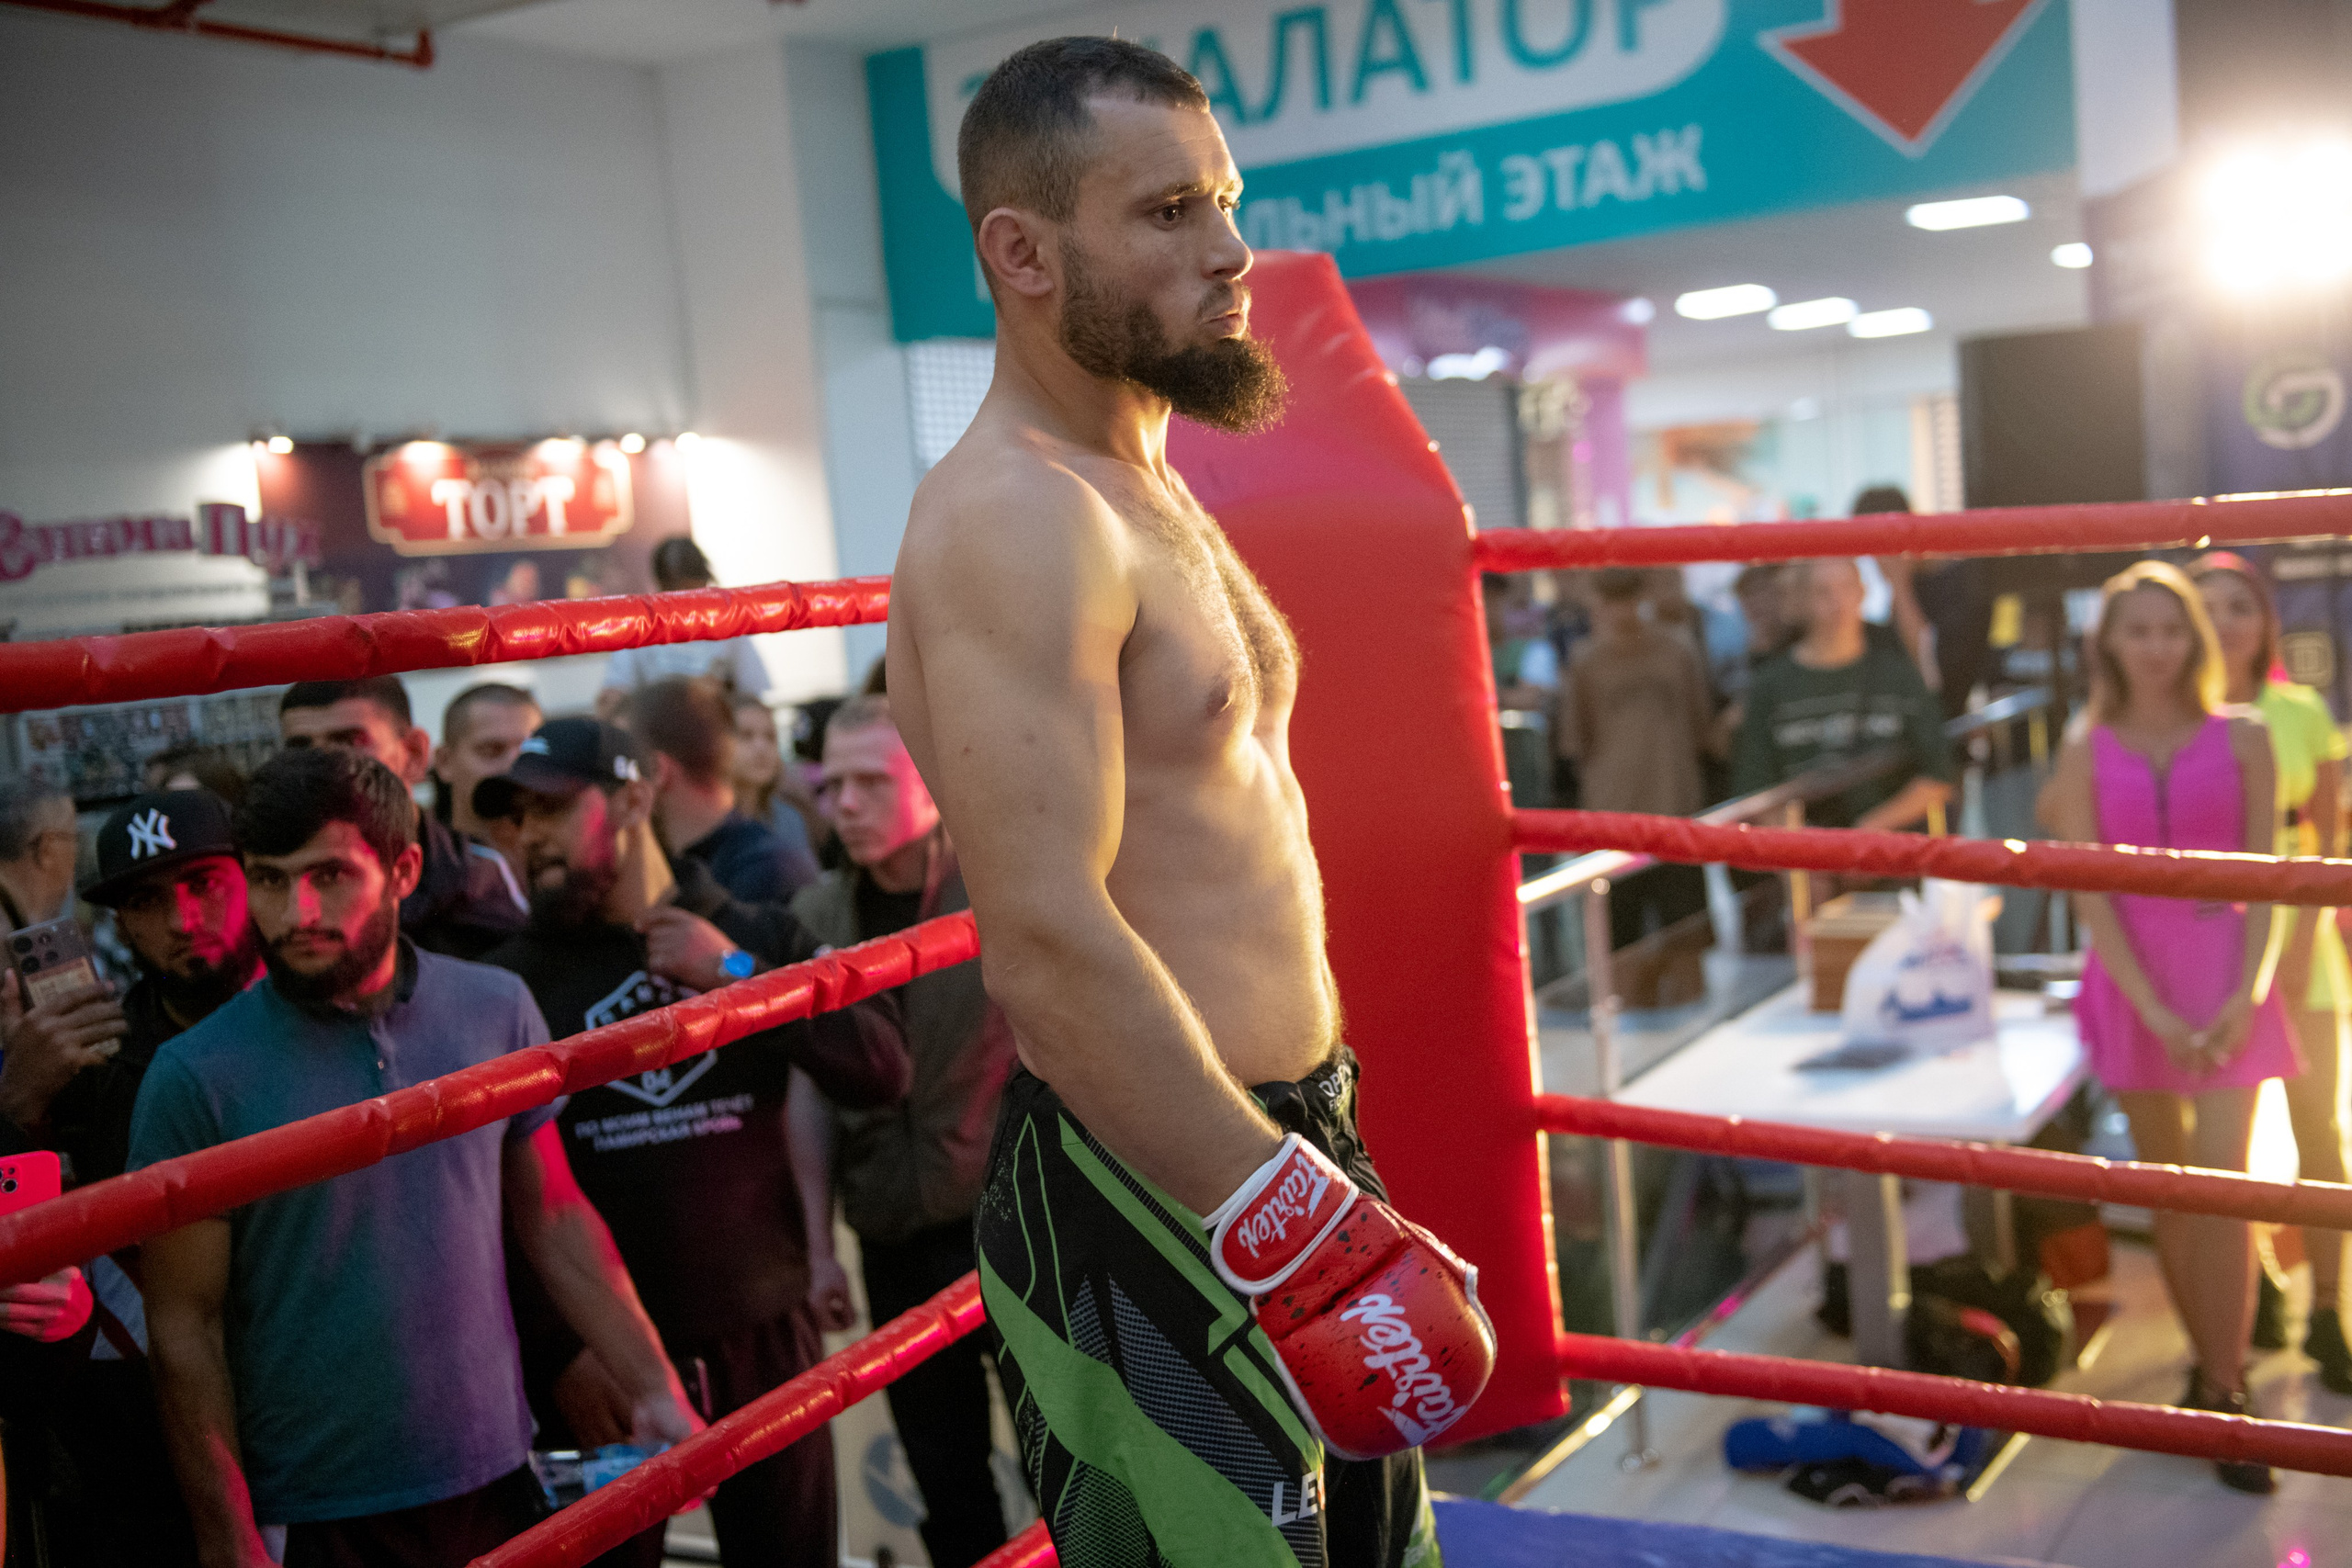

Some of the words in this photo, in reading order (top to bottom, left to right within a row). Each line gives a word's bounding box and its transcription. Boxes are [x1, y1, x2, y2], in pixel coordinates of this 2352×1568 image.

[1242, 149, 1485, 254] ЛЬНЫЙ
[1499, 122, 1708, 221] ЭТАЖ
[430, 475, 567, 542] ТОРТ
[127, 807, 177, 860] NY
[1237, 1153, 1330, 1259] Fairtex
[1340, 1293, 1468, 1448] Fairtex
